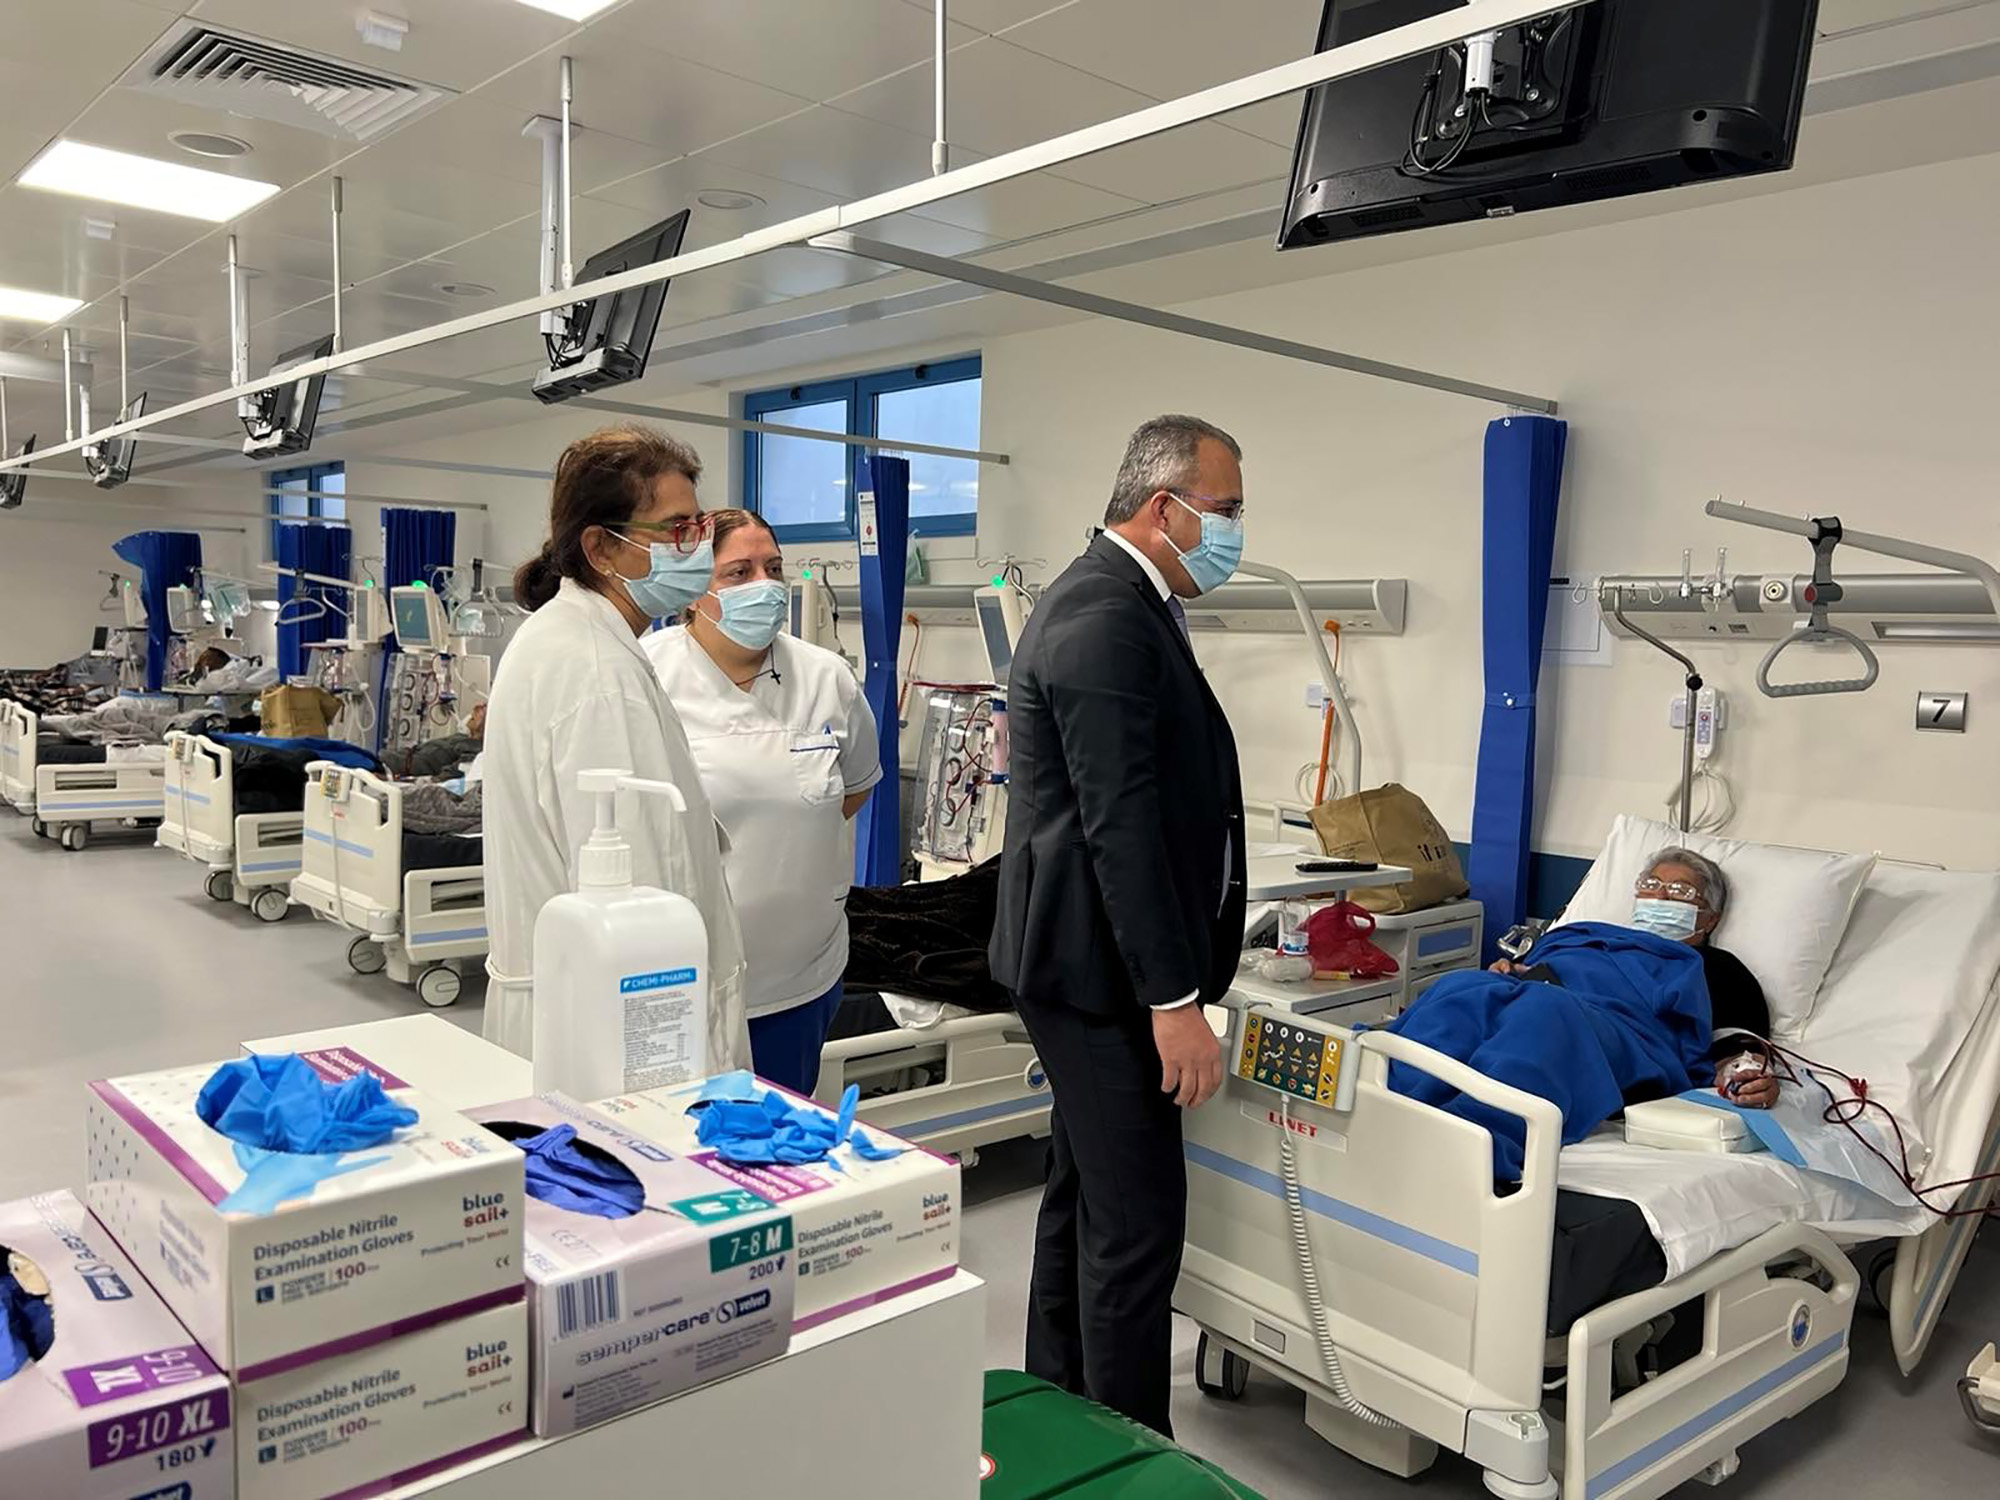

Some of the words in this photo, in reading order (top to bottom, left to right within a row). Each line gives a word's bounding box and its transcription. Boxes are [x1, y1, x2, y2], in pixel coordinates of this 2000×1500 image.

[1933, 699, 1950, 723] 7
[1269, 1111, 1317, 1138] LINET
[463, 1193, 504, 1211] blue
[923, 1193, 948, 1208] blue
[254, 1227, 346, 1261] Disposable
[349, 1213, 398, 1237] Nitrile
[798, 1219, 852, 1243] Disposable
[854, 1209, 883, 1227] Nitrile
[730, 1231, 761, 1263] 7-8
[766, 1225, 783, 1252] M
[798, 1233, 860, 1259] Examination
[861, 1222, 893, 1239] Gloves
[845, 1245, 864, 1260] 100
[255, 1245, 359, 1281] Examination
[362, 1229, 415, 1252] Gloves
[335, 1261, 366, 1281] 100
[750, 1261, 775, 1280] 200
[466, 1340, 508, 1362] blue
[257, 1385, 348, 1422] Disposable
[351, 1369, 400, 1394] Nitrile
[258, 1402, 361, 1442] Examination
[364, 1384, 417, 1408] Gloves
[107, 1411, 170, 1459] 9-10
[178, 1399, 215, 1437] XL
[339, 1417, 368, 1438] 100
[157, 1445, 197, 1471] 180
